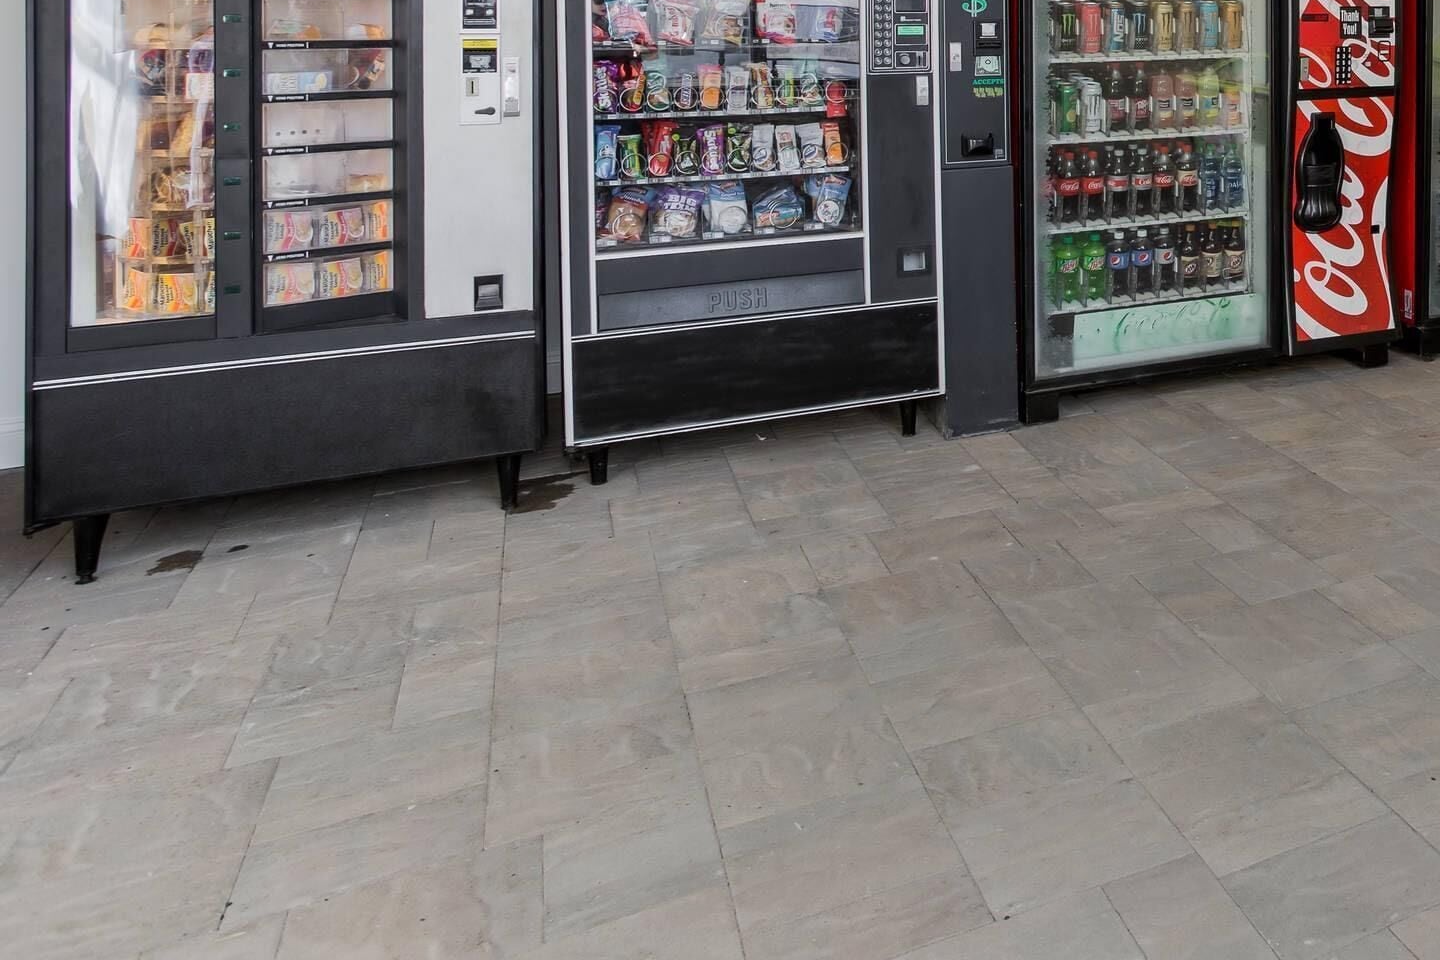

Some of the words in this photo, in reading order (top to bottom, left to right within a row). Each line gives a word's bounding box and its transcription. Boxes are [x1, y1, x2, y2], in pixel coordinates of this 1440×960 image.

[1341, 9, 1360, 22] Thank
[1113, 14, 1125, 43] NOS
[1342, 23, 1358, 35] You!
[704, 130, 720, 171] Skittles
[667, 194, 697, 207] BIG
[707, 287, 768, 314] PUSH
